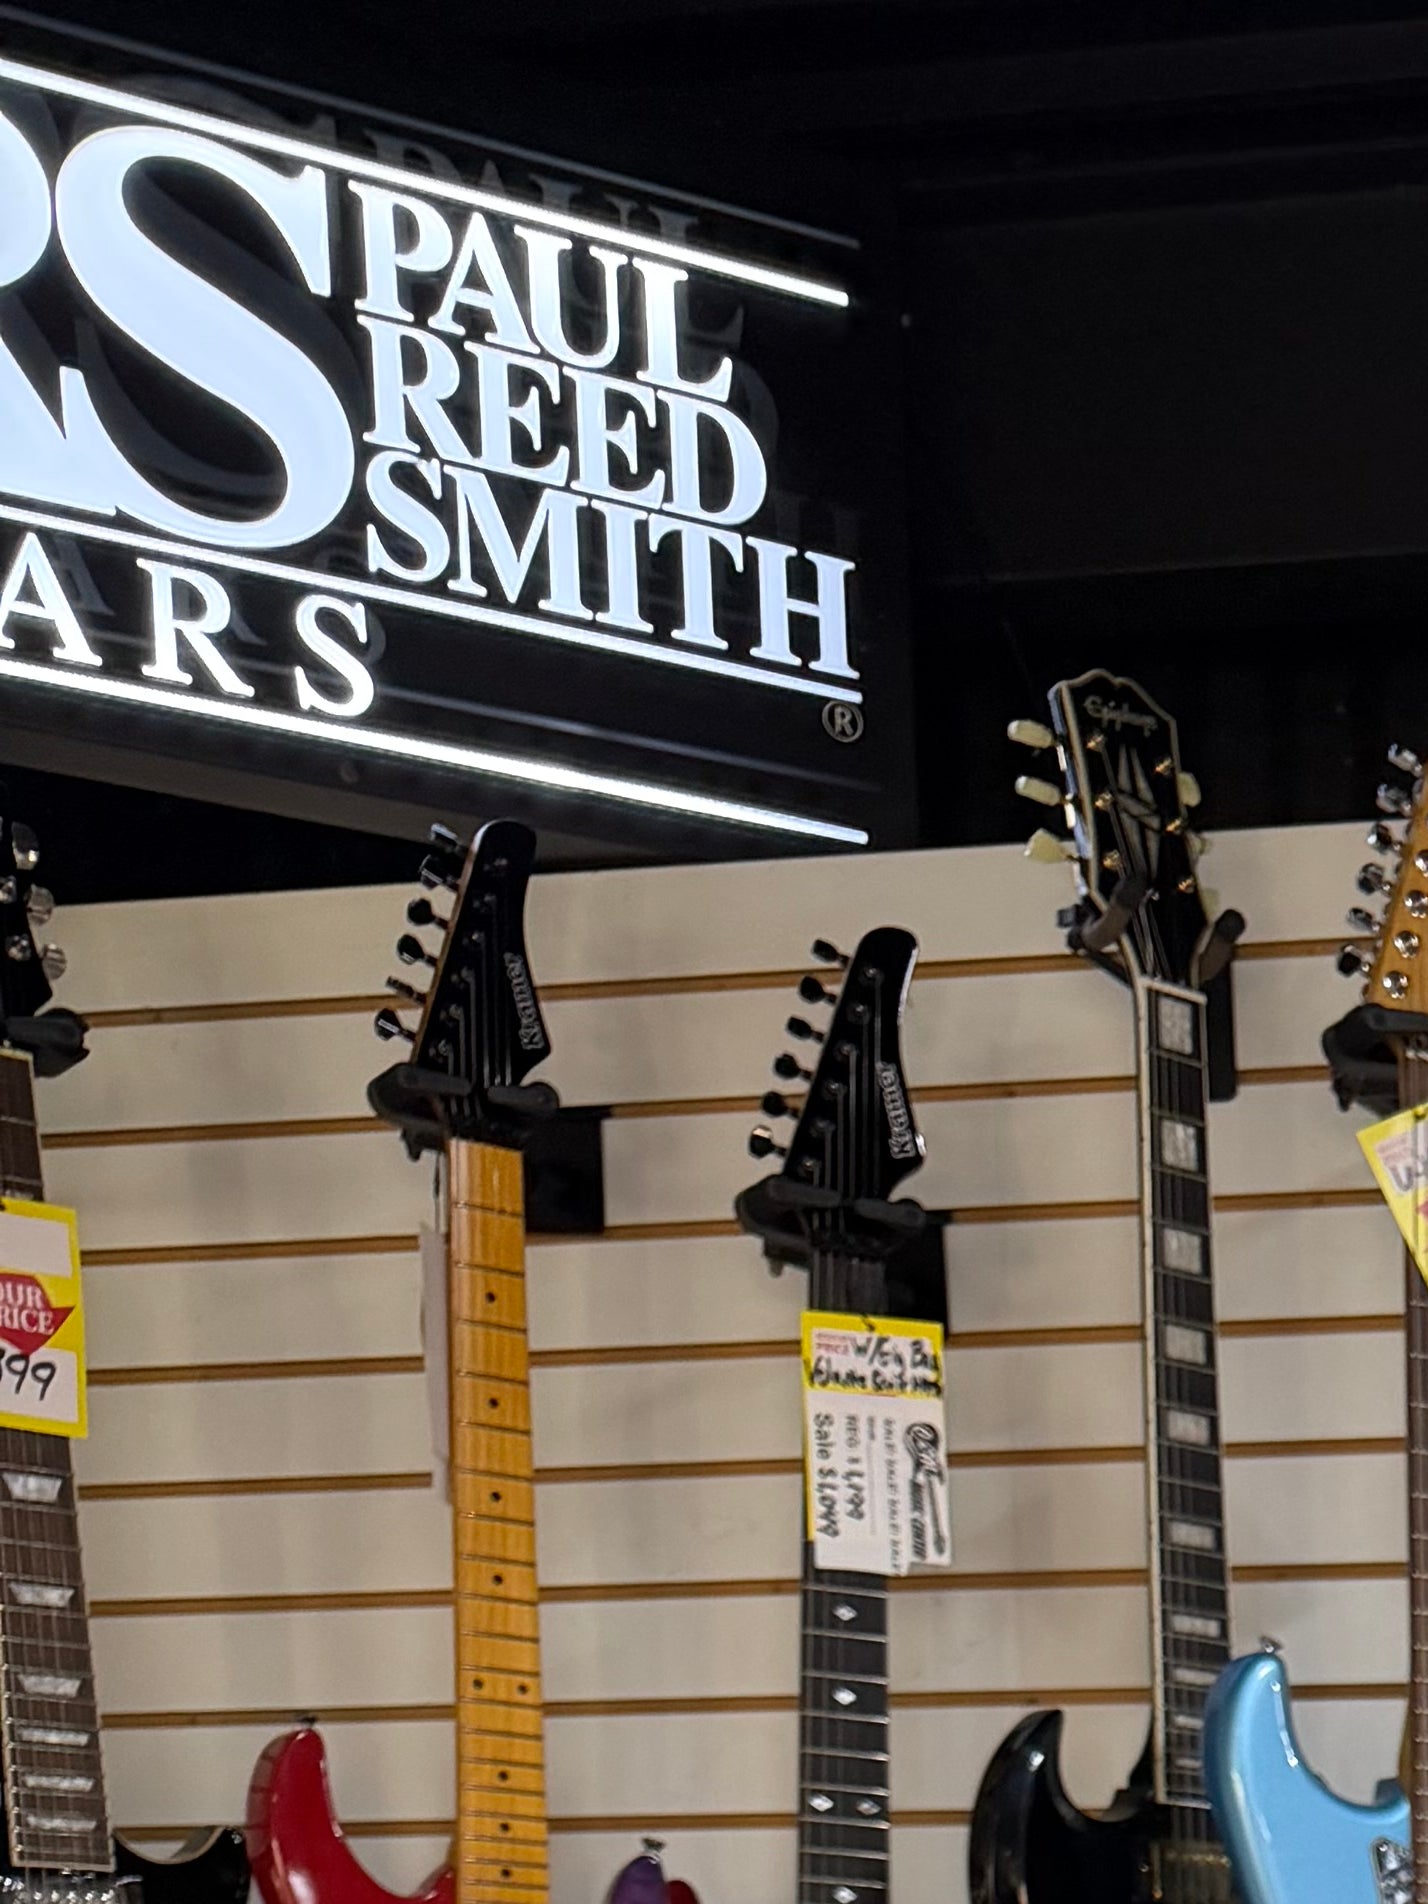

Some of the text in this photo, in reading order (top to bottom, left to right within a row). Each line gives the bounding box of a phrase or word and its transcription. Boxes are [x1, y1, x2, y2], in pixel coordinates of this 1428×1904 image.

[349, 177, 732, 402] PAUL
[357, 314, 767, 527] REED
[365, 451, 861, 681] SMITH
[503, 951, 545, 1050] Kramer
[874, 1060, 917, 1160] Kramer
[0, 1347, 57, 1401] 99
[814, 1411, 836, 1460] Sale
